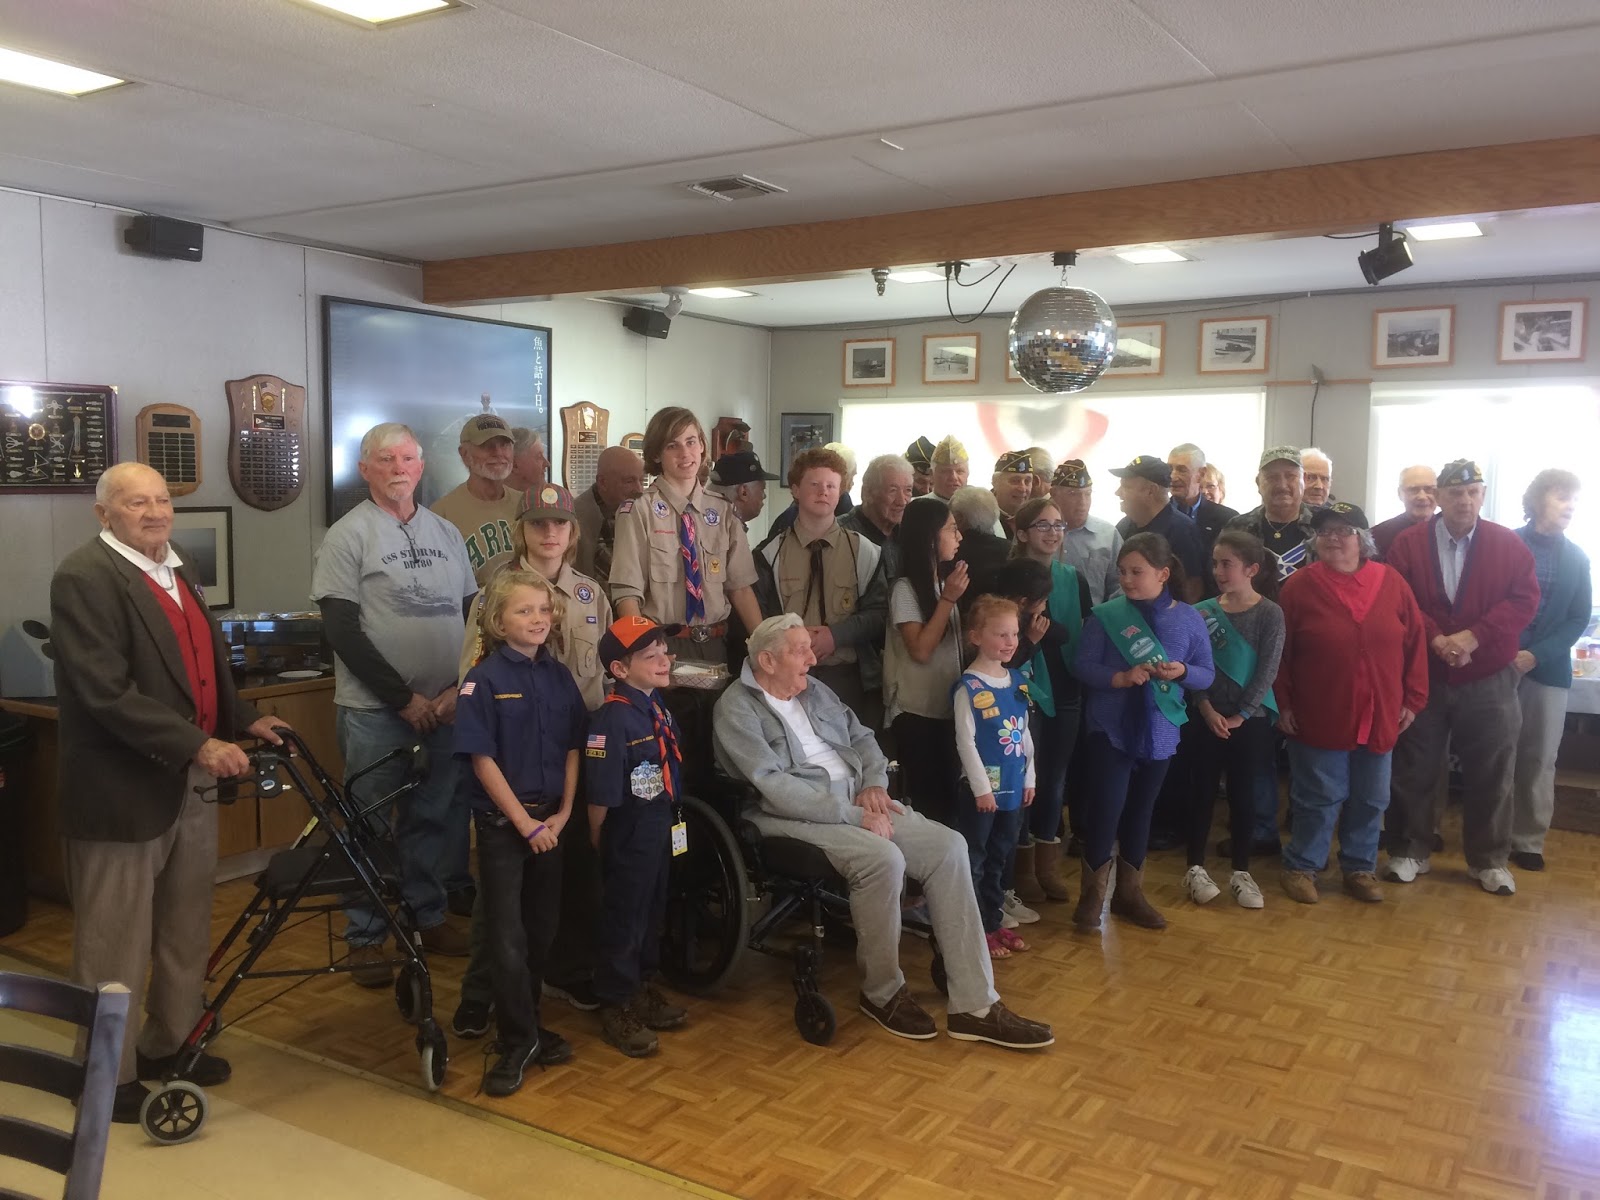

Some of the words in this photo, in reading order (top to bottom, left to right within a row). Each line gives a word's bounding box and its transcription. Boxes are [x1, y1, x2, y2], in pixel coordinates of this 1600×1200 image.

[533, 336, 544, 414] 魚と話す日。
[381, 552, 398, 565] USS
